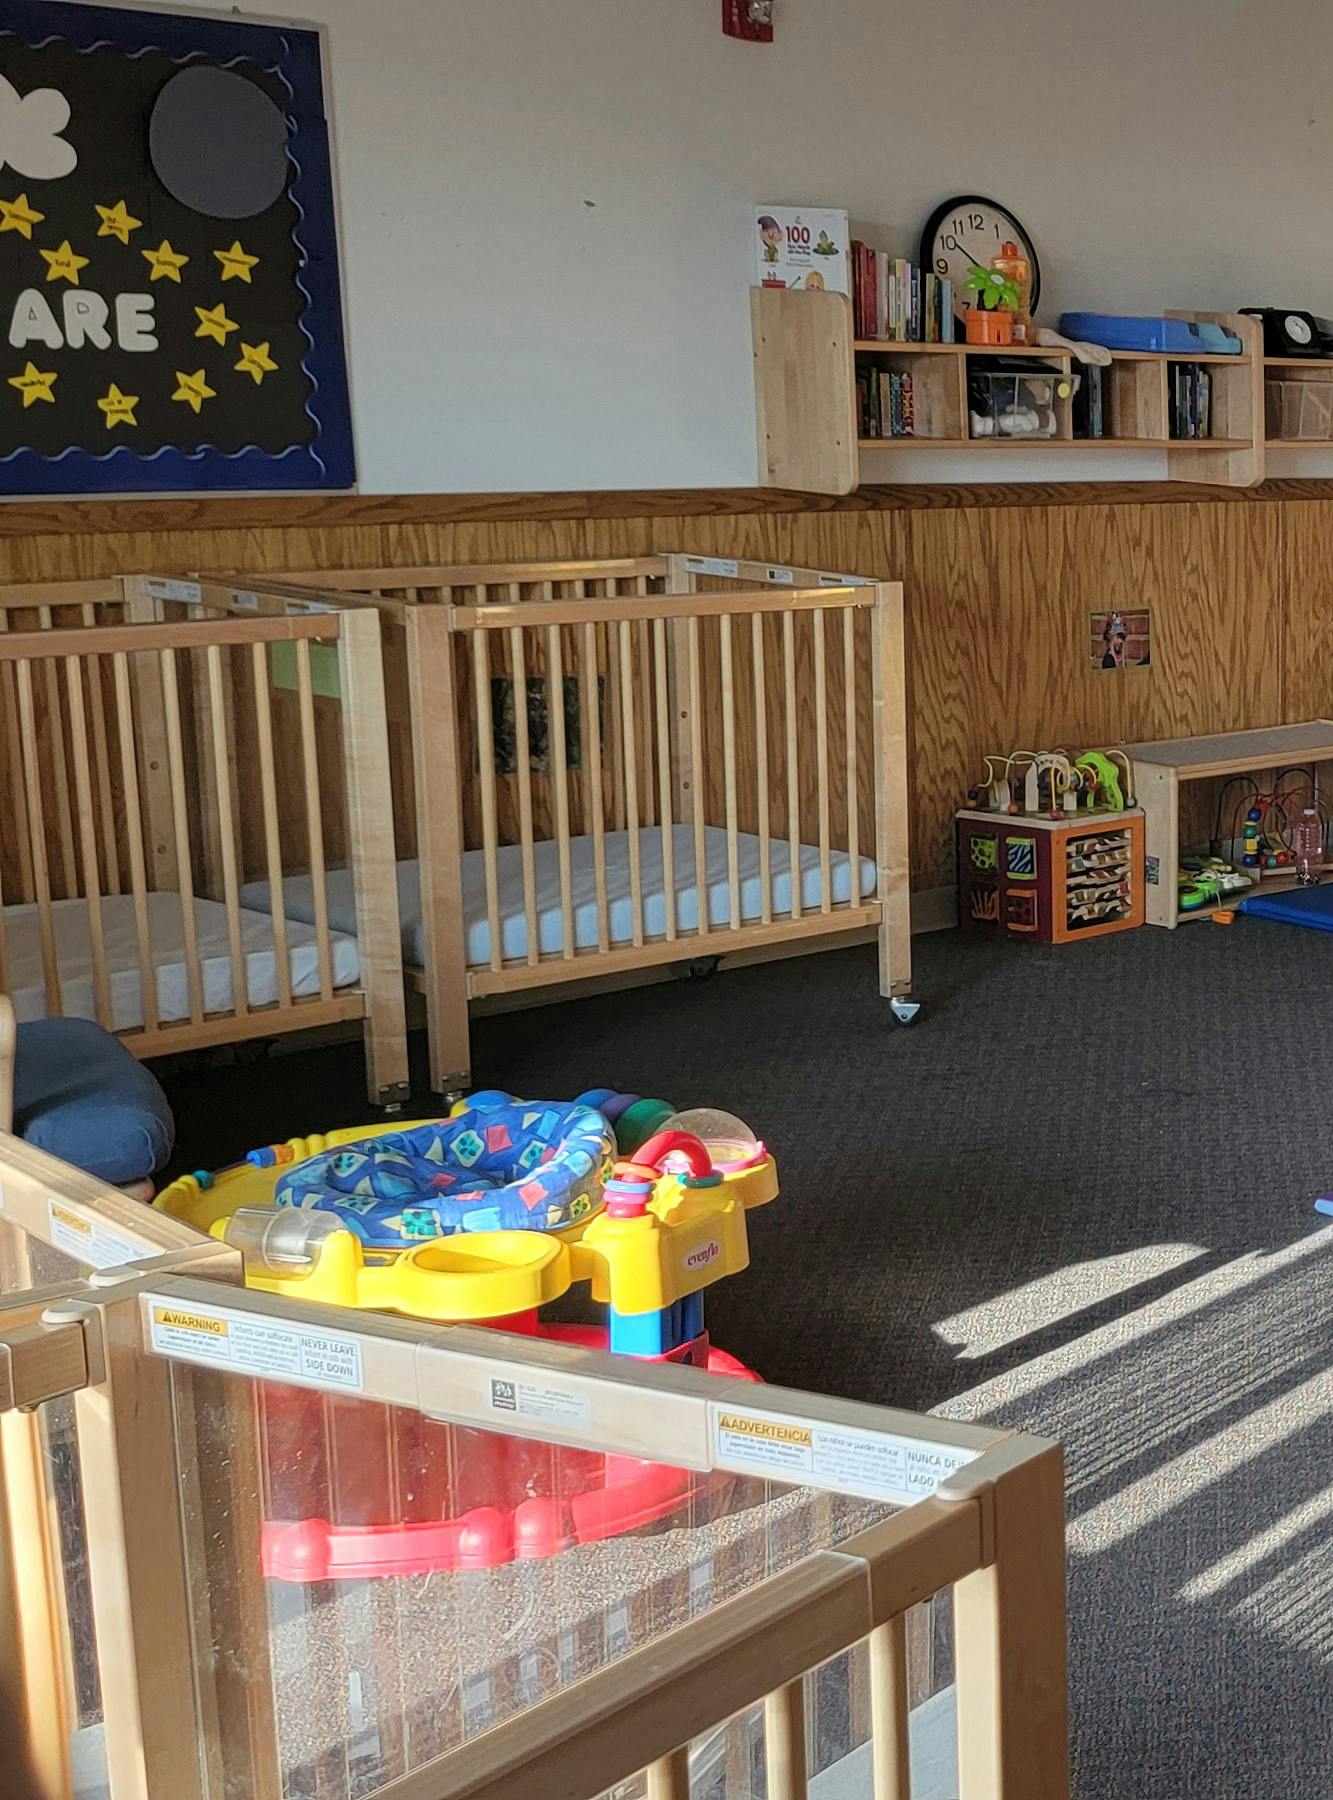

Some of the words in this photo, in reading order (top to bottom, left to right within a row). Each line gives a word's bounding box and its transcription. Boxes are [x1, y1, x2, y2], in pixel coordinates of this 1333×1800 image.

[952, 219, 964, 235] 11
[968, 214, 984, 230] 12
[786, 226, 810, 244] 100
[994, 224, 1000, 238] 1
[940, 234, 956, 250] 10
[936, 258, 948, 274] 9
[9, 288, 159, 352] ARE
[688, 1243, 718, 1266] evenflo
[171, 1311, 221, 1333] WARNING
[301, 1337, 327, 1353] NEVER
[330, 1341, 355, 1357] LEAVE
[306, 1358, 324, 1371] SIDE
[327, 1362, 353, 1376] DOWN
[732, 1419, 810, 1442] ADVERTENCIA
[907, 1451, 943, 1467] NUNCA
[908, 1473, 935, 1487] LADO
